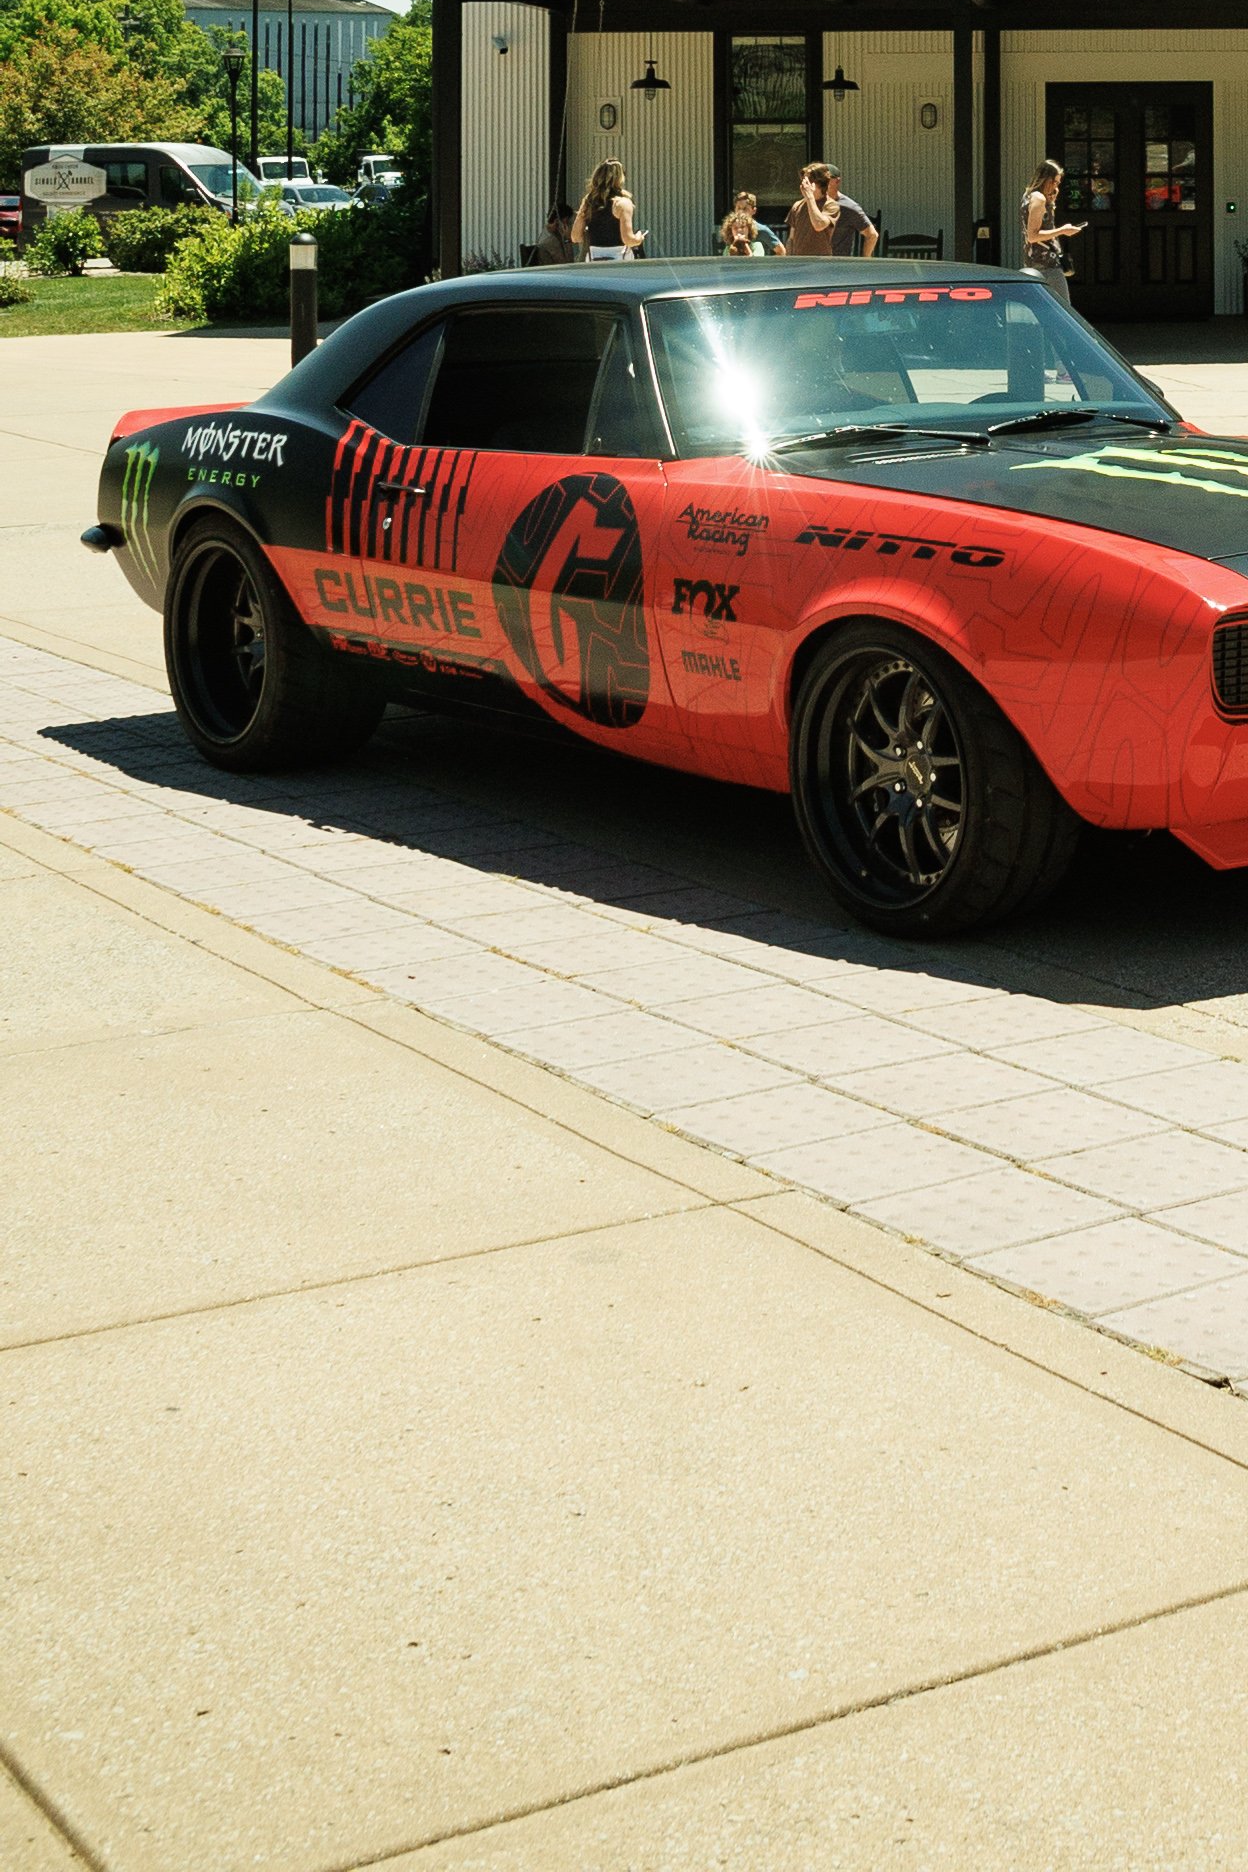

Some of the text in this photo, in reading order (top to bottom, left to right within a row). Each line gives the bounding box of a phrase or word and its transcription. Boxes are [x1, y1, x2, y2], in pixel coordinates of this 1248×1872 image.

[793, 287, 993, 309] NITTO
[187, 468, 260, 488] ENERGY
[677, 502, 770, 530] American
[687, 518, 751, 557] Racing
[794, 525, 1005, 567] NITTO
[314, 568, 482, 639] CURRIE
[671, 578, 741, 622] FOX
[681, 649, 742, 682] MAHLE
